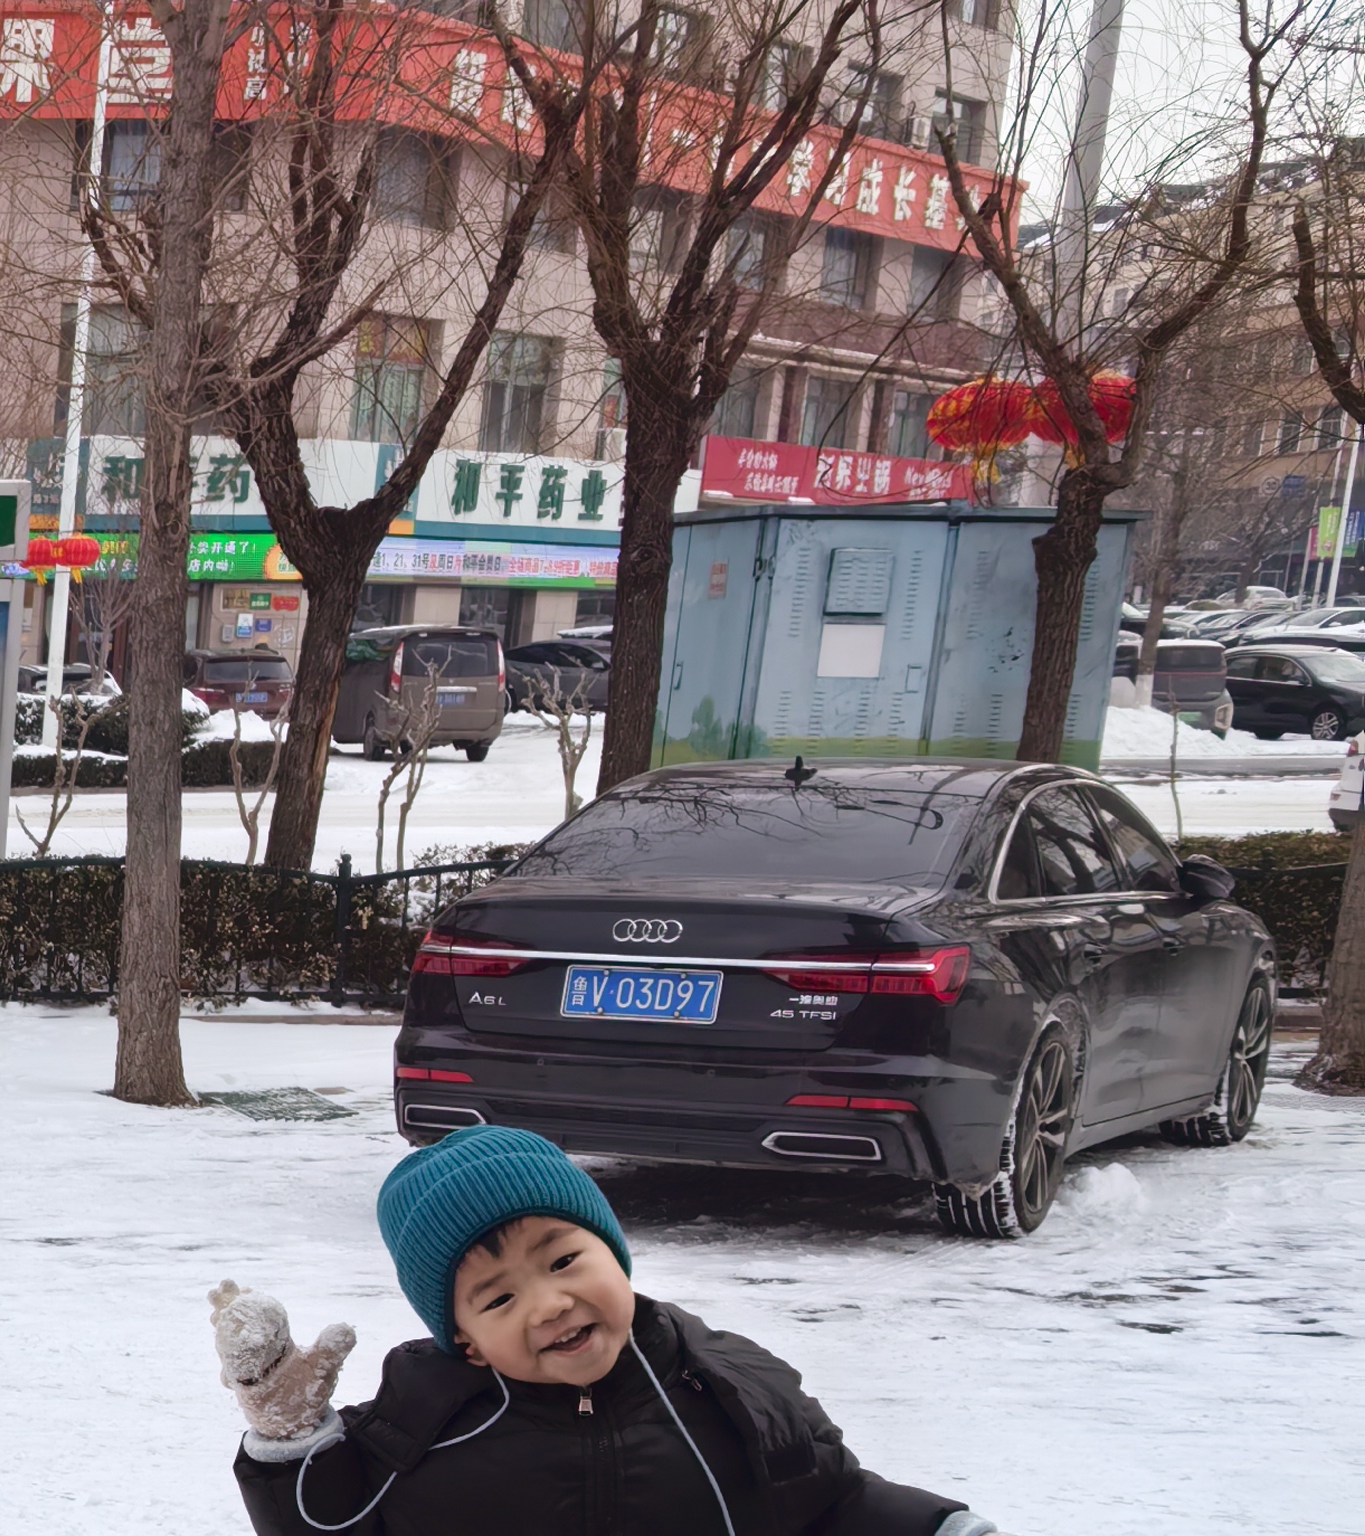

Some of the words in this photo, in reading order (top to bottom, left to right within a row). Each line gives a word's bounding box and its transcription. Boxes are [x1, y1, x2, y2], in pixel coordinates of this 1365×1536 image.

[451, 459, 607, 521] 和平药业
[770, 1009, 795, 1019] 45
[800, 1010, 836, 1020] TFSI
